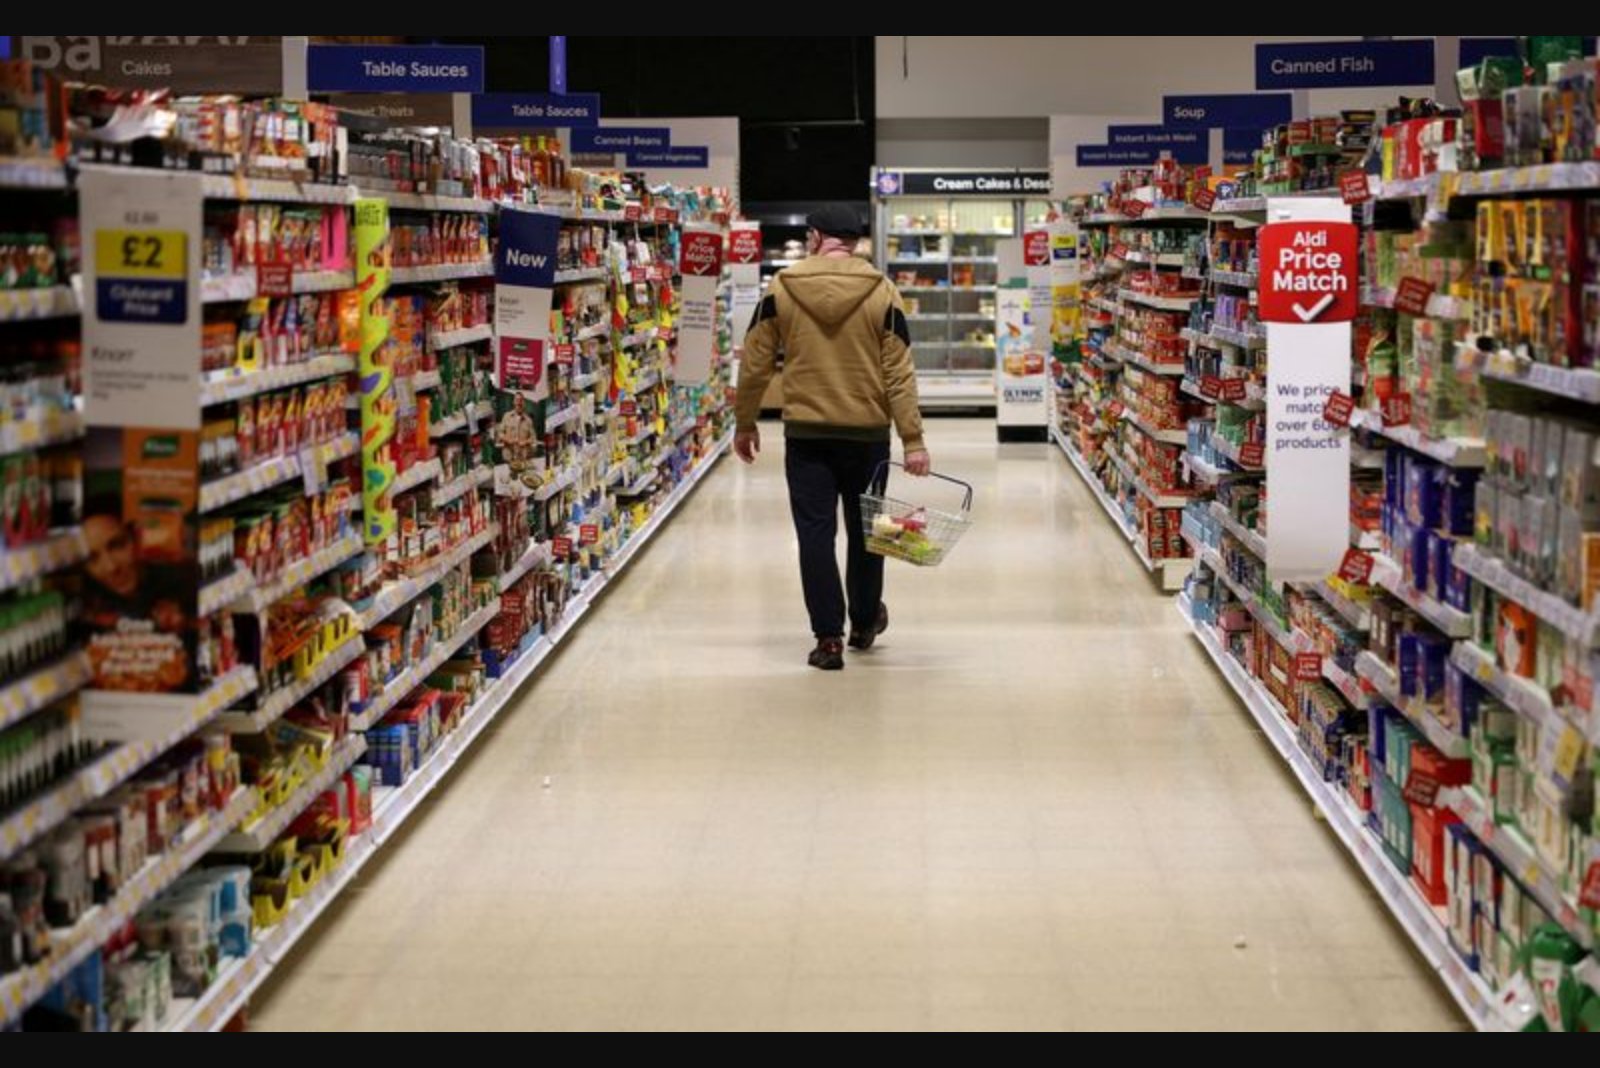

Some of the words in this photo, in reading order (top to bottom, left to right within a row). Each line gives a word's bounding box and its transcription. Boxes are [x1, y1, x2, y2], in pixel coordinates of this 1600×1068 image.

[121, 60, 172, 76] Cakes
[363, 61, 405, 77] Table
[410, 61, 468, 77] Sauces
[1271, 60, 1336, 75] Canned
[1341, 57, 1375, 72] Fish
[512, 105, 543, 117] Table
[546, 105, 588, 118] Sauces
[1173, 106, 1205, 120] Soup
[594, 136, 631, 146] Canned
[633, 136, 662, 146] Beans
[1115, 134, 1144, 143] Instant
[934, 178, 973, 190] Cream
[976, 178, 1011, 190] Cakes
[1013, 178, 1021, 190] &
[1293, 231, 1327, 247] Aldi
[122, 236, 164, 269] £2
[506, 248, 547, 269] New
[1279, 248, 1342, 270] Price
[1272, 270, 1348, 291] Match
[1277, 384, 1299, 397] We
[1286, 401, 1327, 414] matc
[1276, 420, 1307, 431] over
[1276, 436, 1341, 450] products
